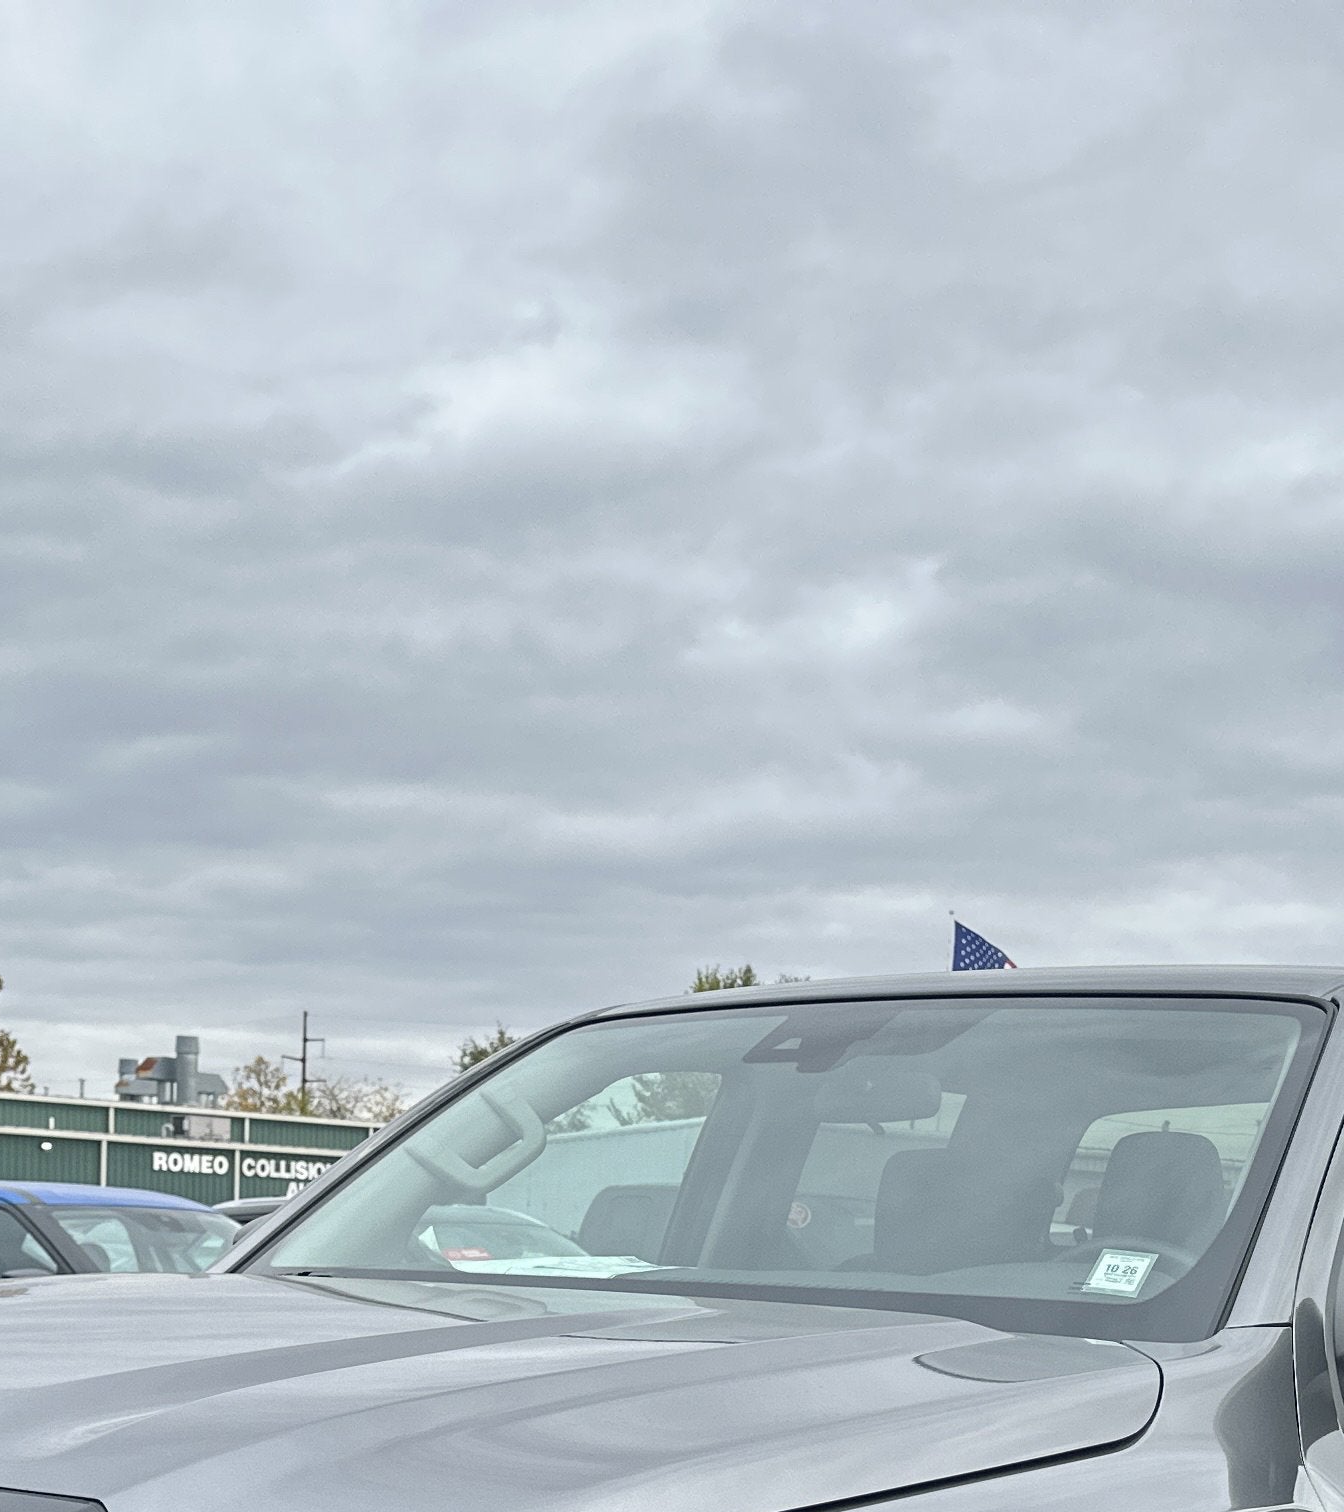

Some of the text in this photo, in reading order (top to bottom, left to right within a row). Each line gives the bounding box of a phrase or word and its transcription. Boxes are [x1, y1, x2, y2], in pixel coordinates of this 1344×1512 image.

[152, 1152, 334, 1181] ROMEO COLLISIO
[1105, 1264, 1138, 1275] 10 26
